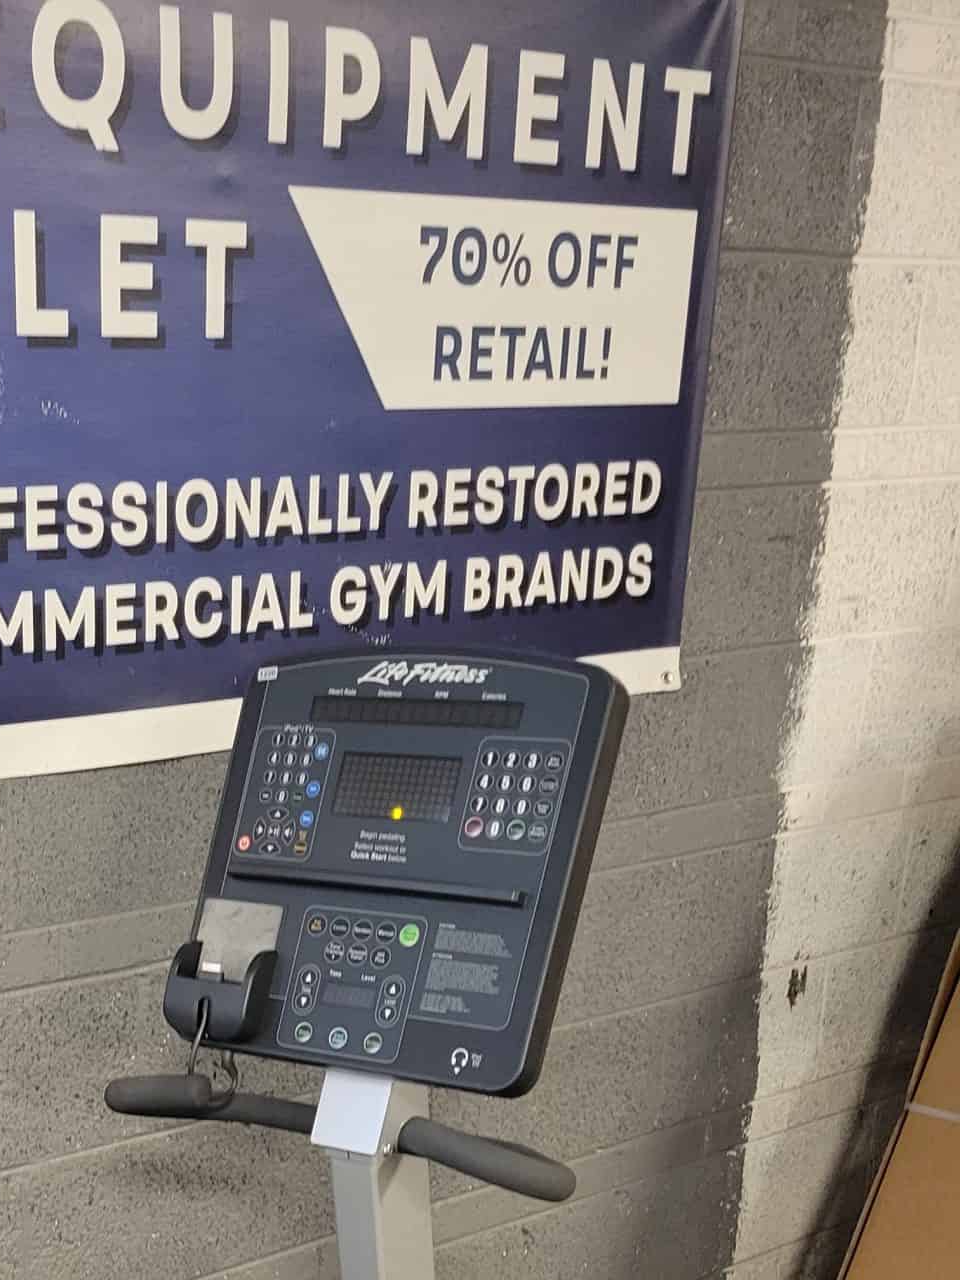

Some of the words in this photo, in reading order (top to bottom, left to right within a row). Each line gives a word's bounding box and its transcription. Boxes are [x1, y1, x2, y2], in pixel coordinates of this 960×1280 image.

[419, 225, 532, 288] 70%
[546, 231, 639, 290] OFF
[432, 324, 613, 382] RETAIL!
[408, 459, 662, 529] RESTORED
[330, 559, 448, 625] GYM
[463, 542, 653, 613] BRANDS
